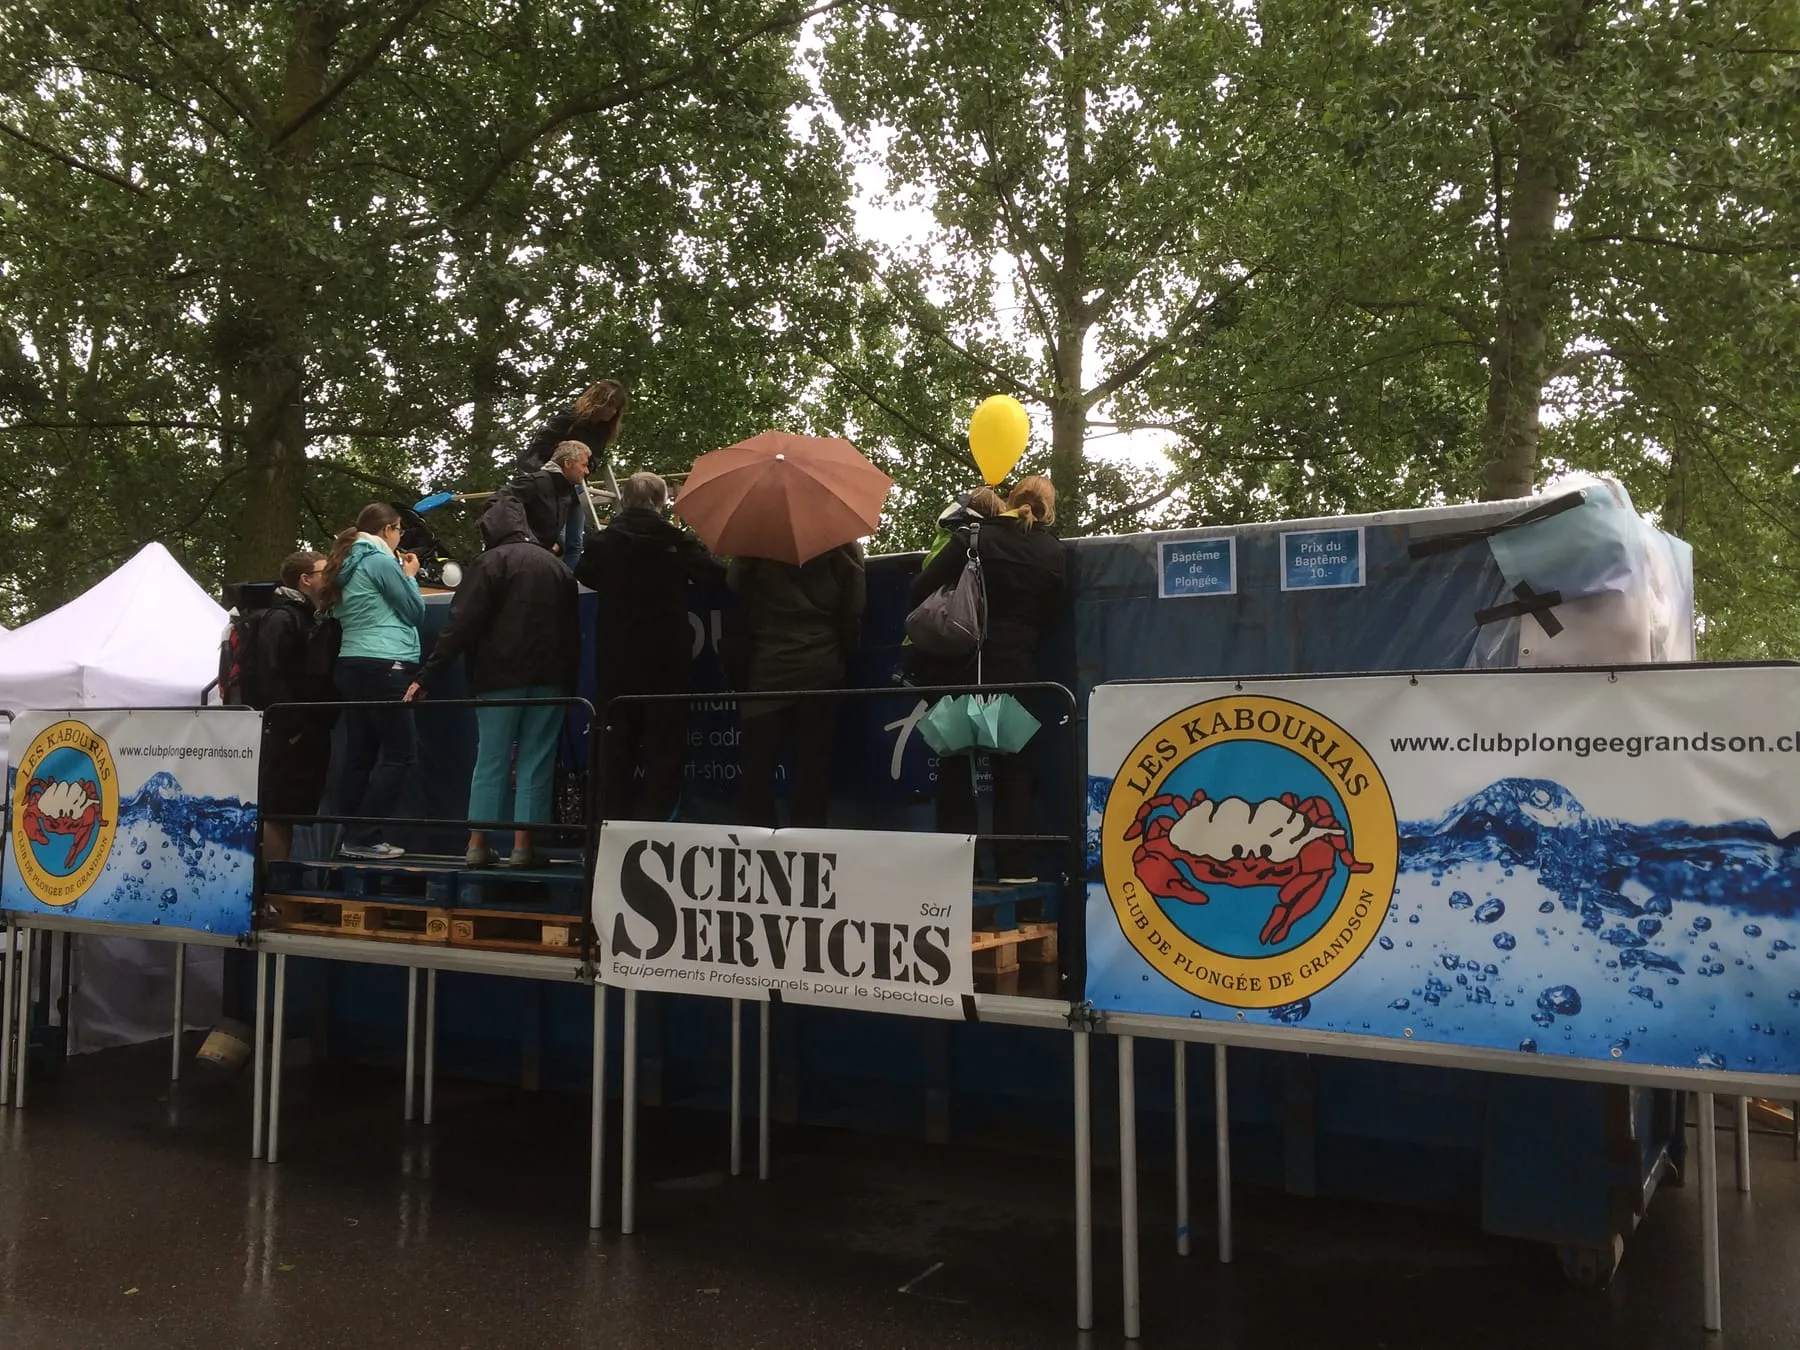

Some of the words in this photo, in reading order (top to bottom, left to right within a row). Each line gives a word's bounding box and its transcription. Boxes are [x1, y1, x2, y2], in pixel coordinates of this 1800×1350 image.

[1172, 551, 1220, 563] Baptême
[1295, 554, 1348, 567] Baptême
[1301, 542, 1324, 553] Prix
[1326, 541, 1341, 551] du
[1175, 575, 1218, 588] Plongée
[1189, 563, 1202, 573] de
[22, 745, 44, 778] LES
[47, 728, 110, 780] KABOURIAS
[119, 745, 253, 759] www.clubplongeegrandson.ch
[1127, 739, 1178, 796] LES
[1181, 708, 1369, 797] KABOURIAS
[17, 830, 27, 860] CLUB
[24, 860, 34, 875] DE
[65, 884, 75, 895] DE
[76, 836, 107, 888] GRANDSON
[613, 834, 837, 959] SCÈNE
[1122, 881, 1148, 930] CLUB
[1147, 930, 1171, 955] DE
[1173, 953, 1261, 991] PLONGÉE
[1269, 972, 1294, 991] DE
[1299, 889, 1374, 978] GRANDSON
[612, 962, 706, 981] Equipements
[710, 972, 809, 992] Professionnels
[814, 982, 848, 995] pour
[854, 985, 868, 997] le
[873, 986, 954, 1007] Spectacle
